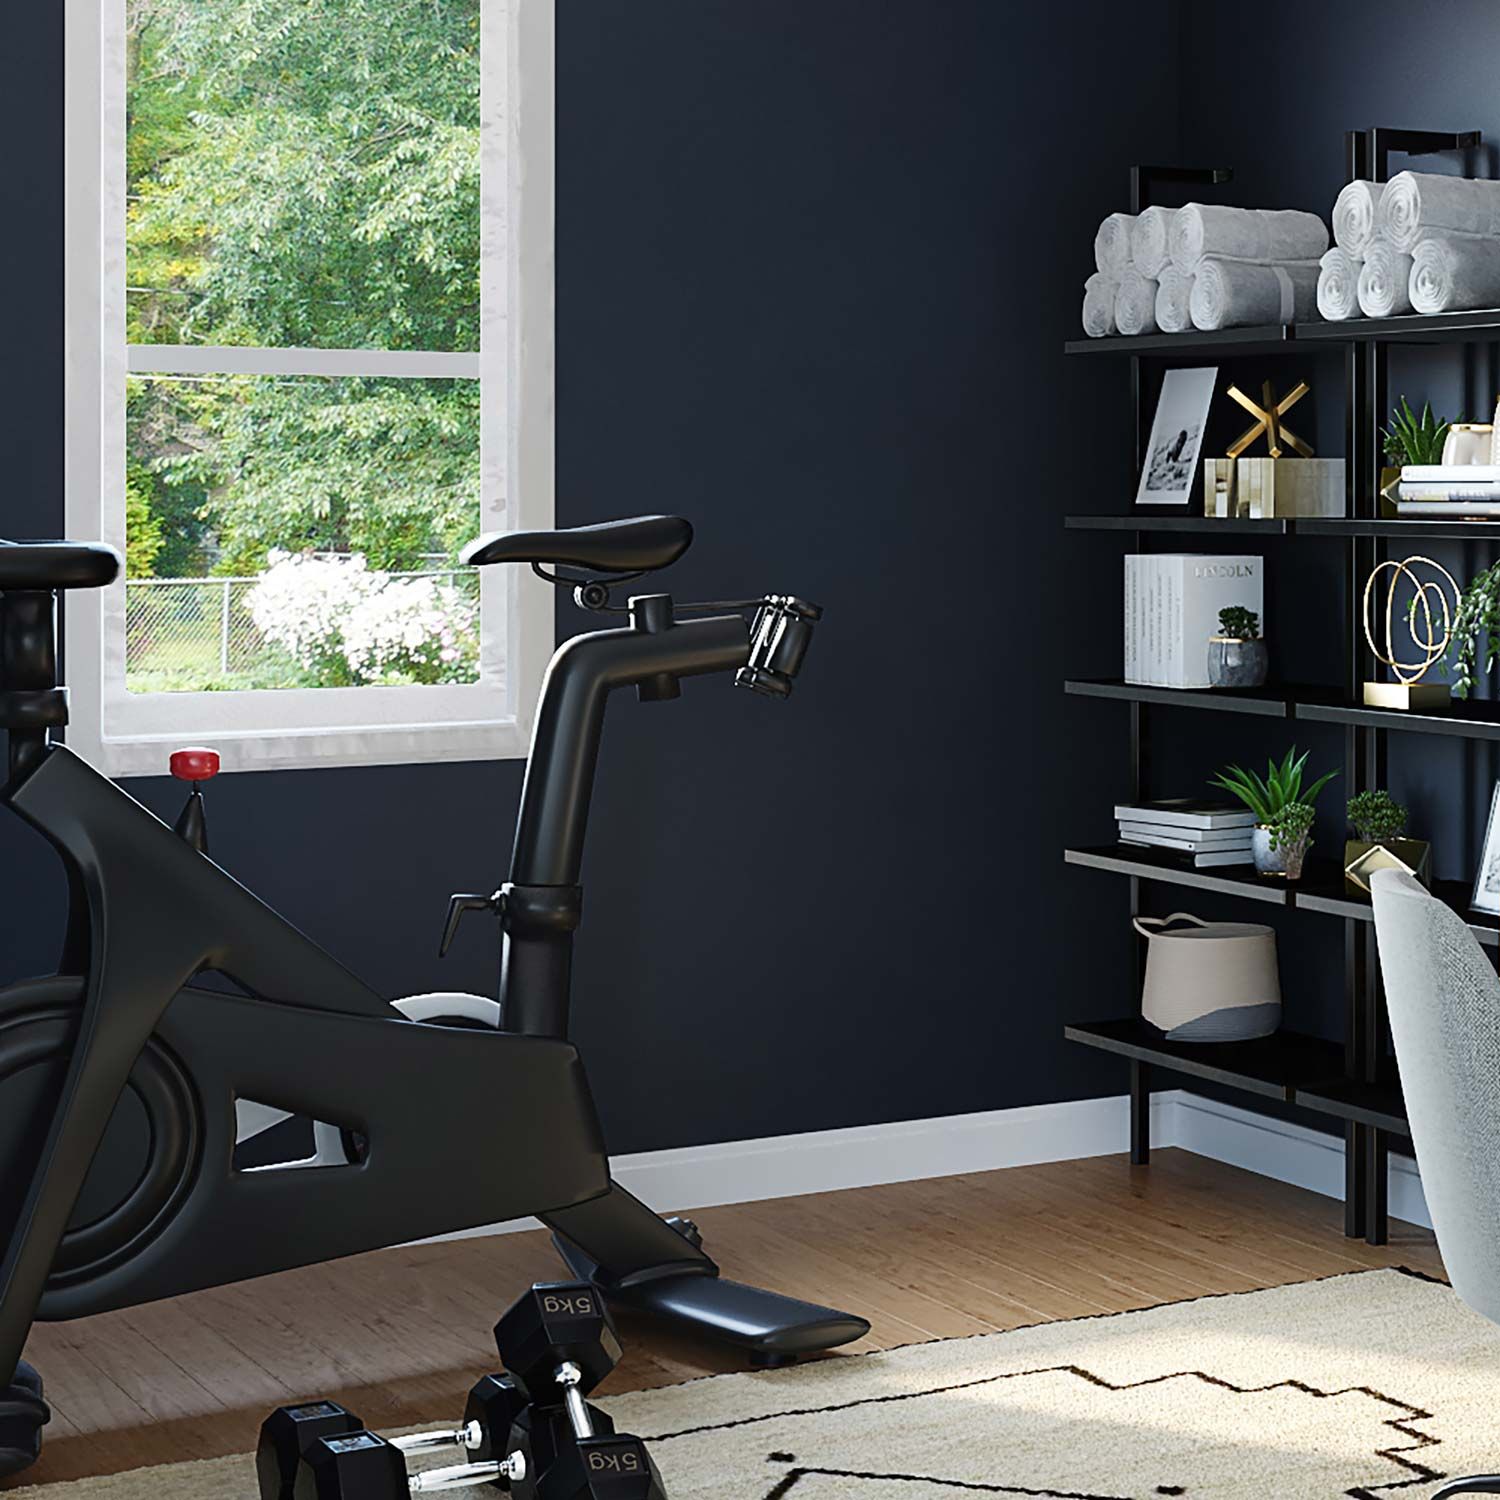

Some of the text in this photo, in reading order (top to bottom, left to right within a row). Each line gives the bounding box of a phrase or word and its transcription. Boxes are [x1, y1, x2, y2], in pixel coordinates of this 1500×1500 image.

[1193, 564, 1254, 578] LINCOLN
[544, 1296, 591, 1314] 5kg
[589, 1452, 637, 1471] 5kg
